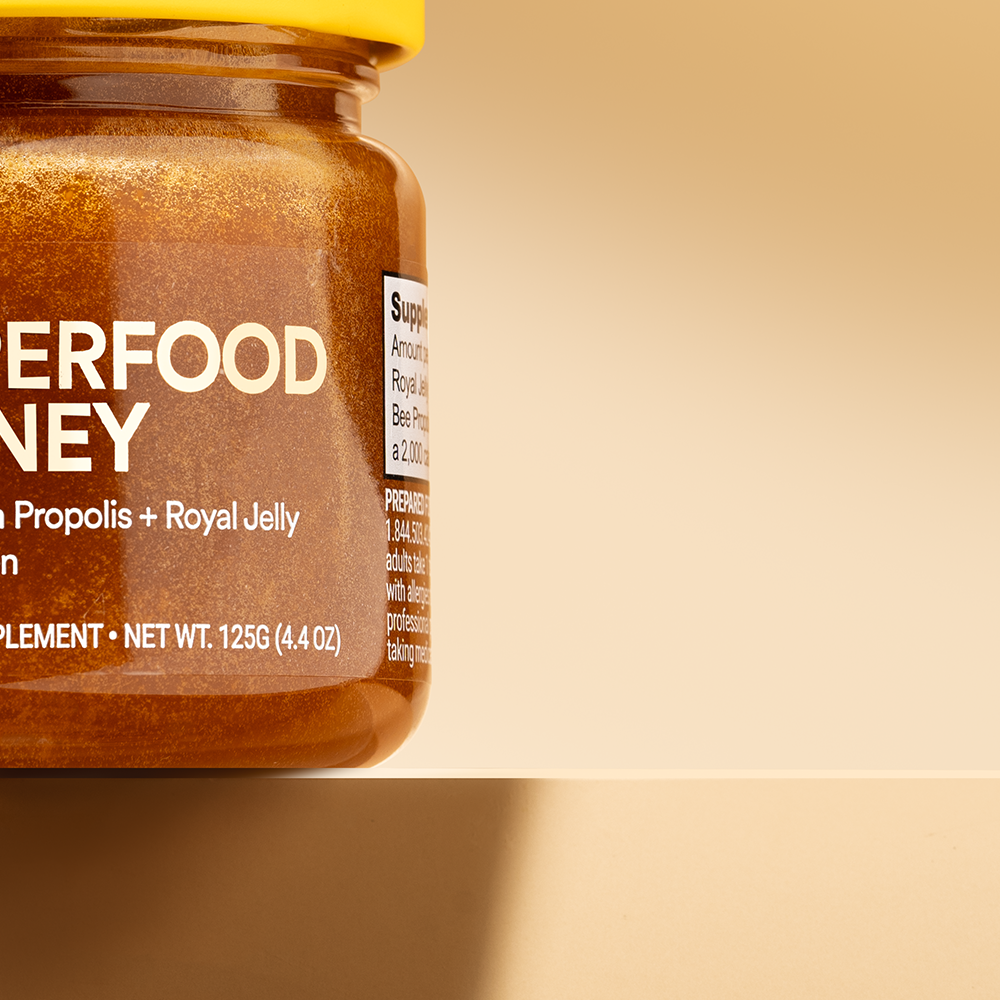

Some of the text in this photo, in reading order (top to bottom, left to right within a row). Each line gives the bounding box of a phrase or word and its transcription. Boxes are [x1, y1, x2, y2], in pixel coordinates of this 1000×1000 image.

[391, 333, 422, 363] Amount
[392, 368, 417, 399] Royal
[392, 403, 411, 428] Bee
[392, 442, 400, 461] a
[401, 438, 423, 466] 2,000
[385, 487, 425, 516] PREPARED
[14, 499, 133, 536] Propolis
[138, 506, 158, 528] +
[165, 499, 238, 537] Royal
[243, 501, 301, 539] Jelly
[385, 547, 413, 573] adults
[413, 550, 426, 575] take
[385, 578, 406, 602] with
[124, 622, 171, 649] NET
[174, 622, 214, 649] WT.
[218, 623, 270, 650] 125G
[274, 622, 310, 657] (4.4
[313, 623, 342, 658] OZ)
[386, 636, 415, 669] taking
